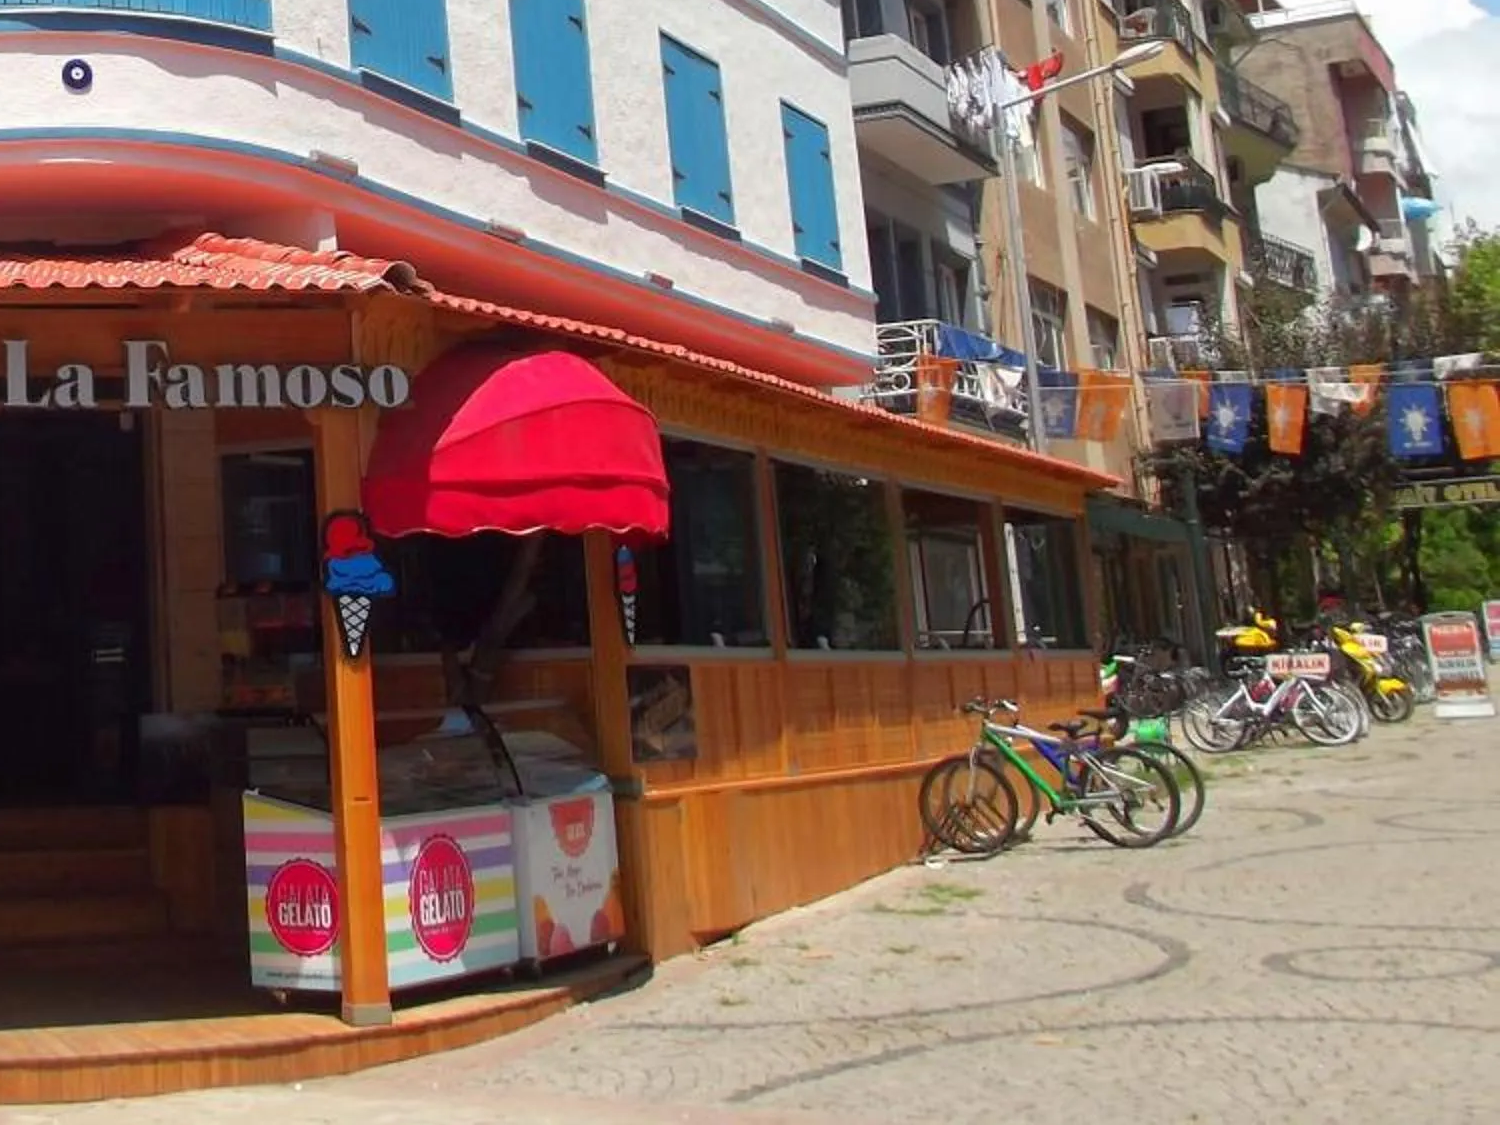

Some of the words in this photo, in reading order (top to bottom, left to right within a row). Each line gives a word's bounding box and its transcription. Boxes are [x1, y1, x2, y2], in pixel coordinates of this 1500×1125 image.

[1, 339, 97, 409] La
[121, 340, 410, 409] Famoso
[277, 902, 332, 929] GELATO
[419, 890, 465, 926] GELATO
